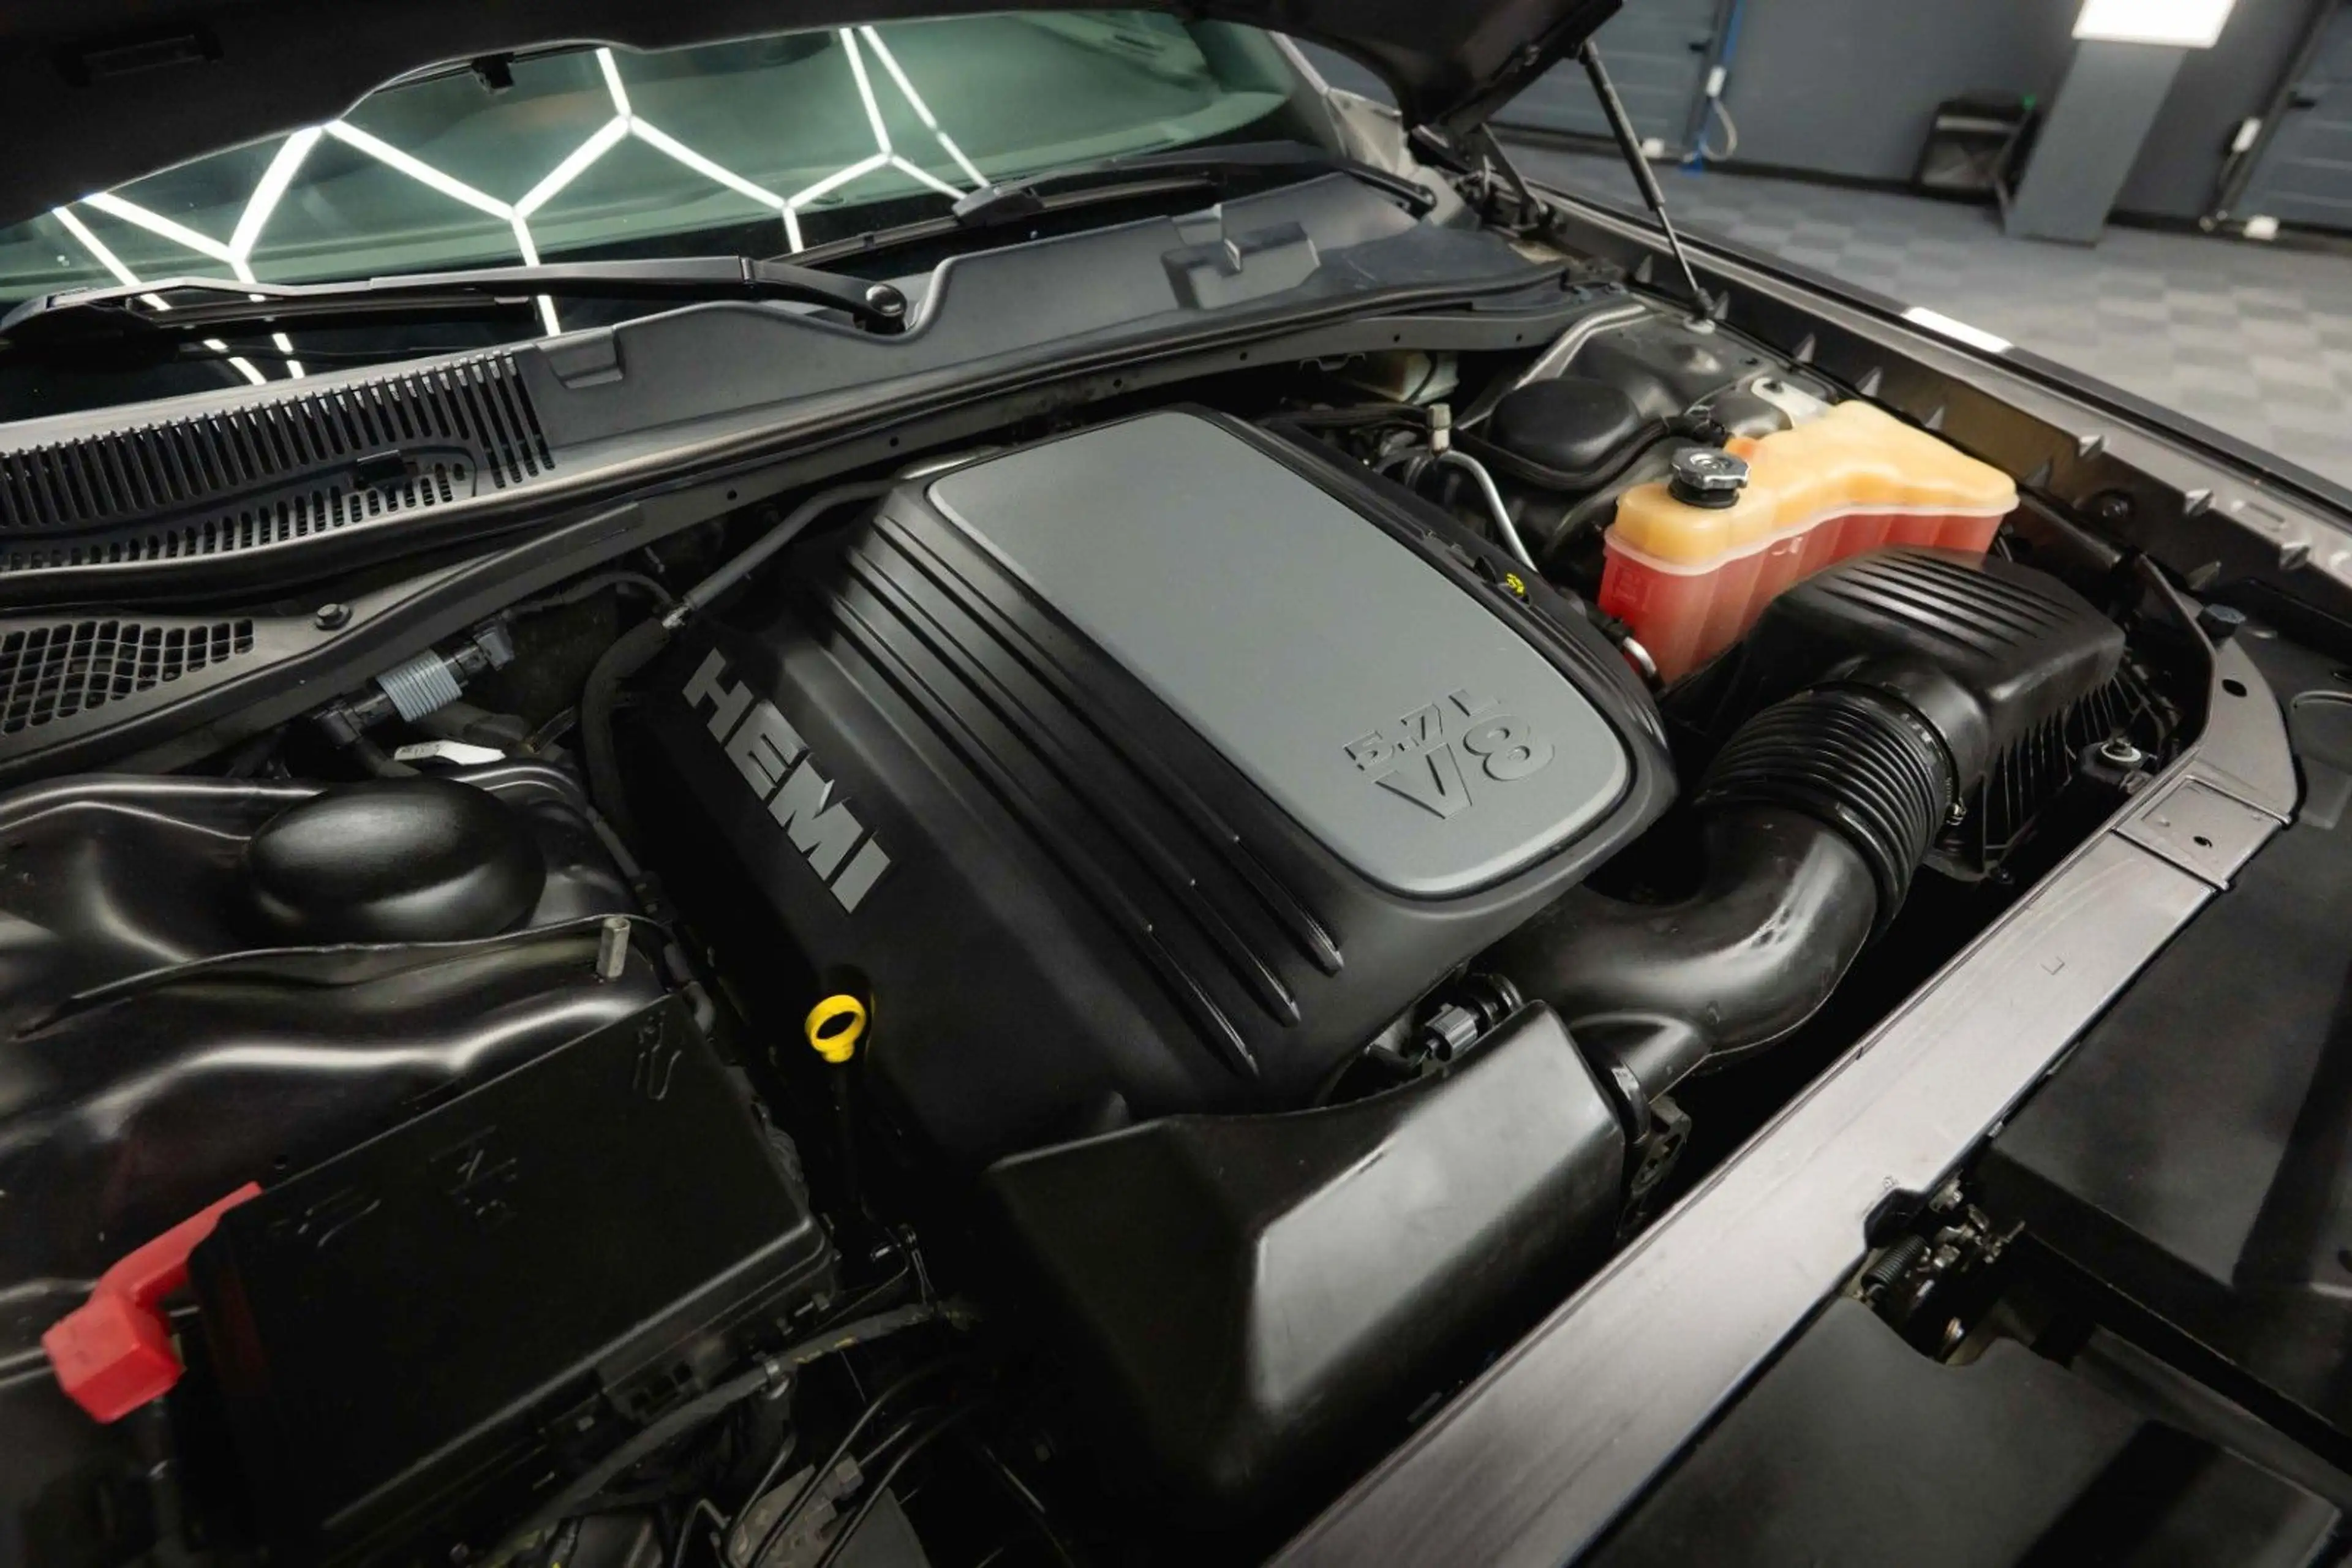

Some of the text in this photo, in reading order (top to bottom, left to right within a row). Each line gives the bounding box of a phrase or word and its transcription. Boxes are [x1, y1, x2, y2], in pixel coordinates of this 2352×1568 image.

[682, 647, 892, 913] HEMI
[1342, 688, 1501, 771] 5.7L
[1371, 714, 1556, 820] V8
